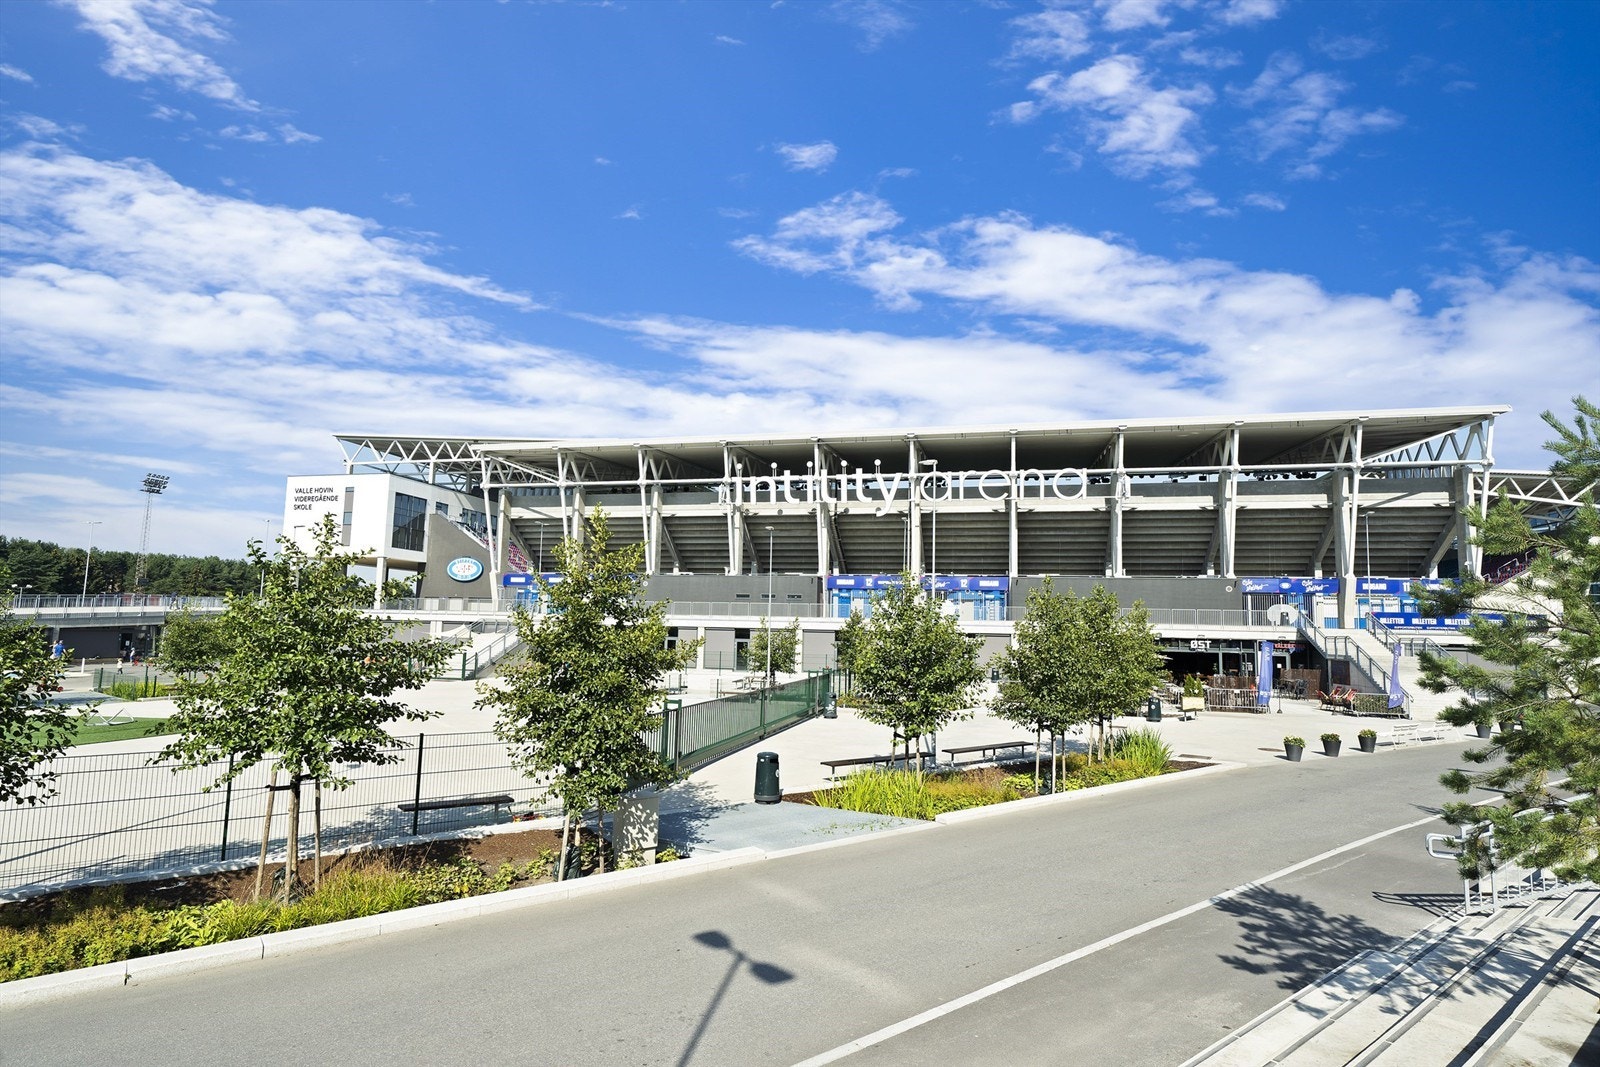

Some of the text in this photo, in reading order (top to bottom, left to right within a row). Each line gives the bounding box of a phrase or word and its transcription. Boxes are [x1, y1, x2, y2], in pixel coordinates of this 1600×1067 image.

[731, 459, 1087, 517] intility arena
[294, 494, 339, 502] VIDEREGÅENDE
[293, 503, 312, 511] SKOLE
[866, 578, 873, 587] 12
[960, 579, 968, 588] 12
[1190, 640, 1212, 649] ØST
